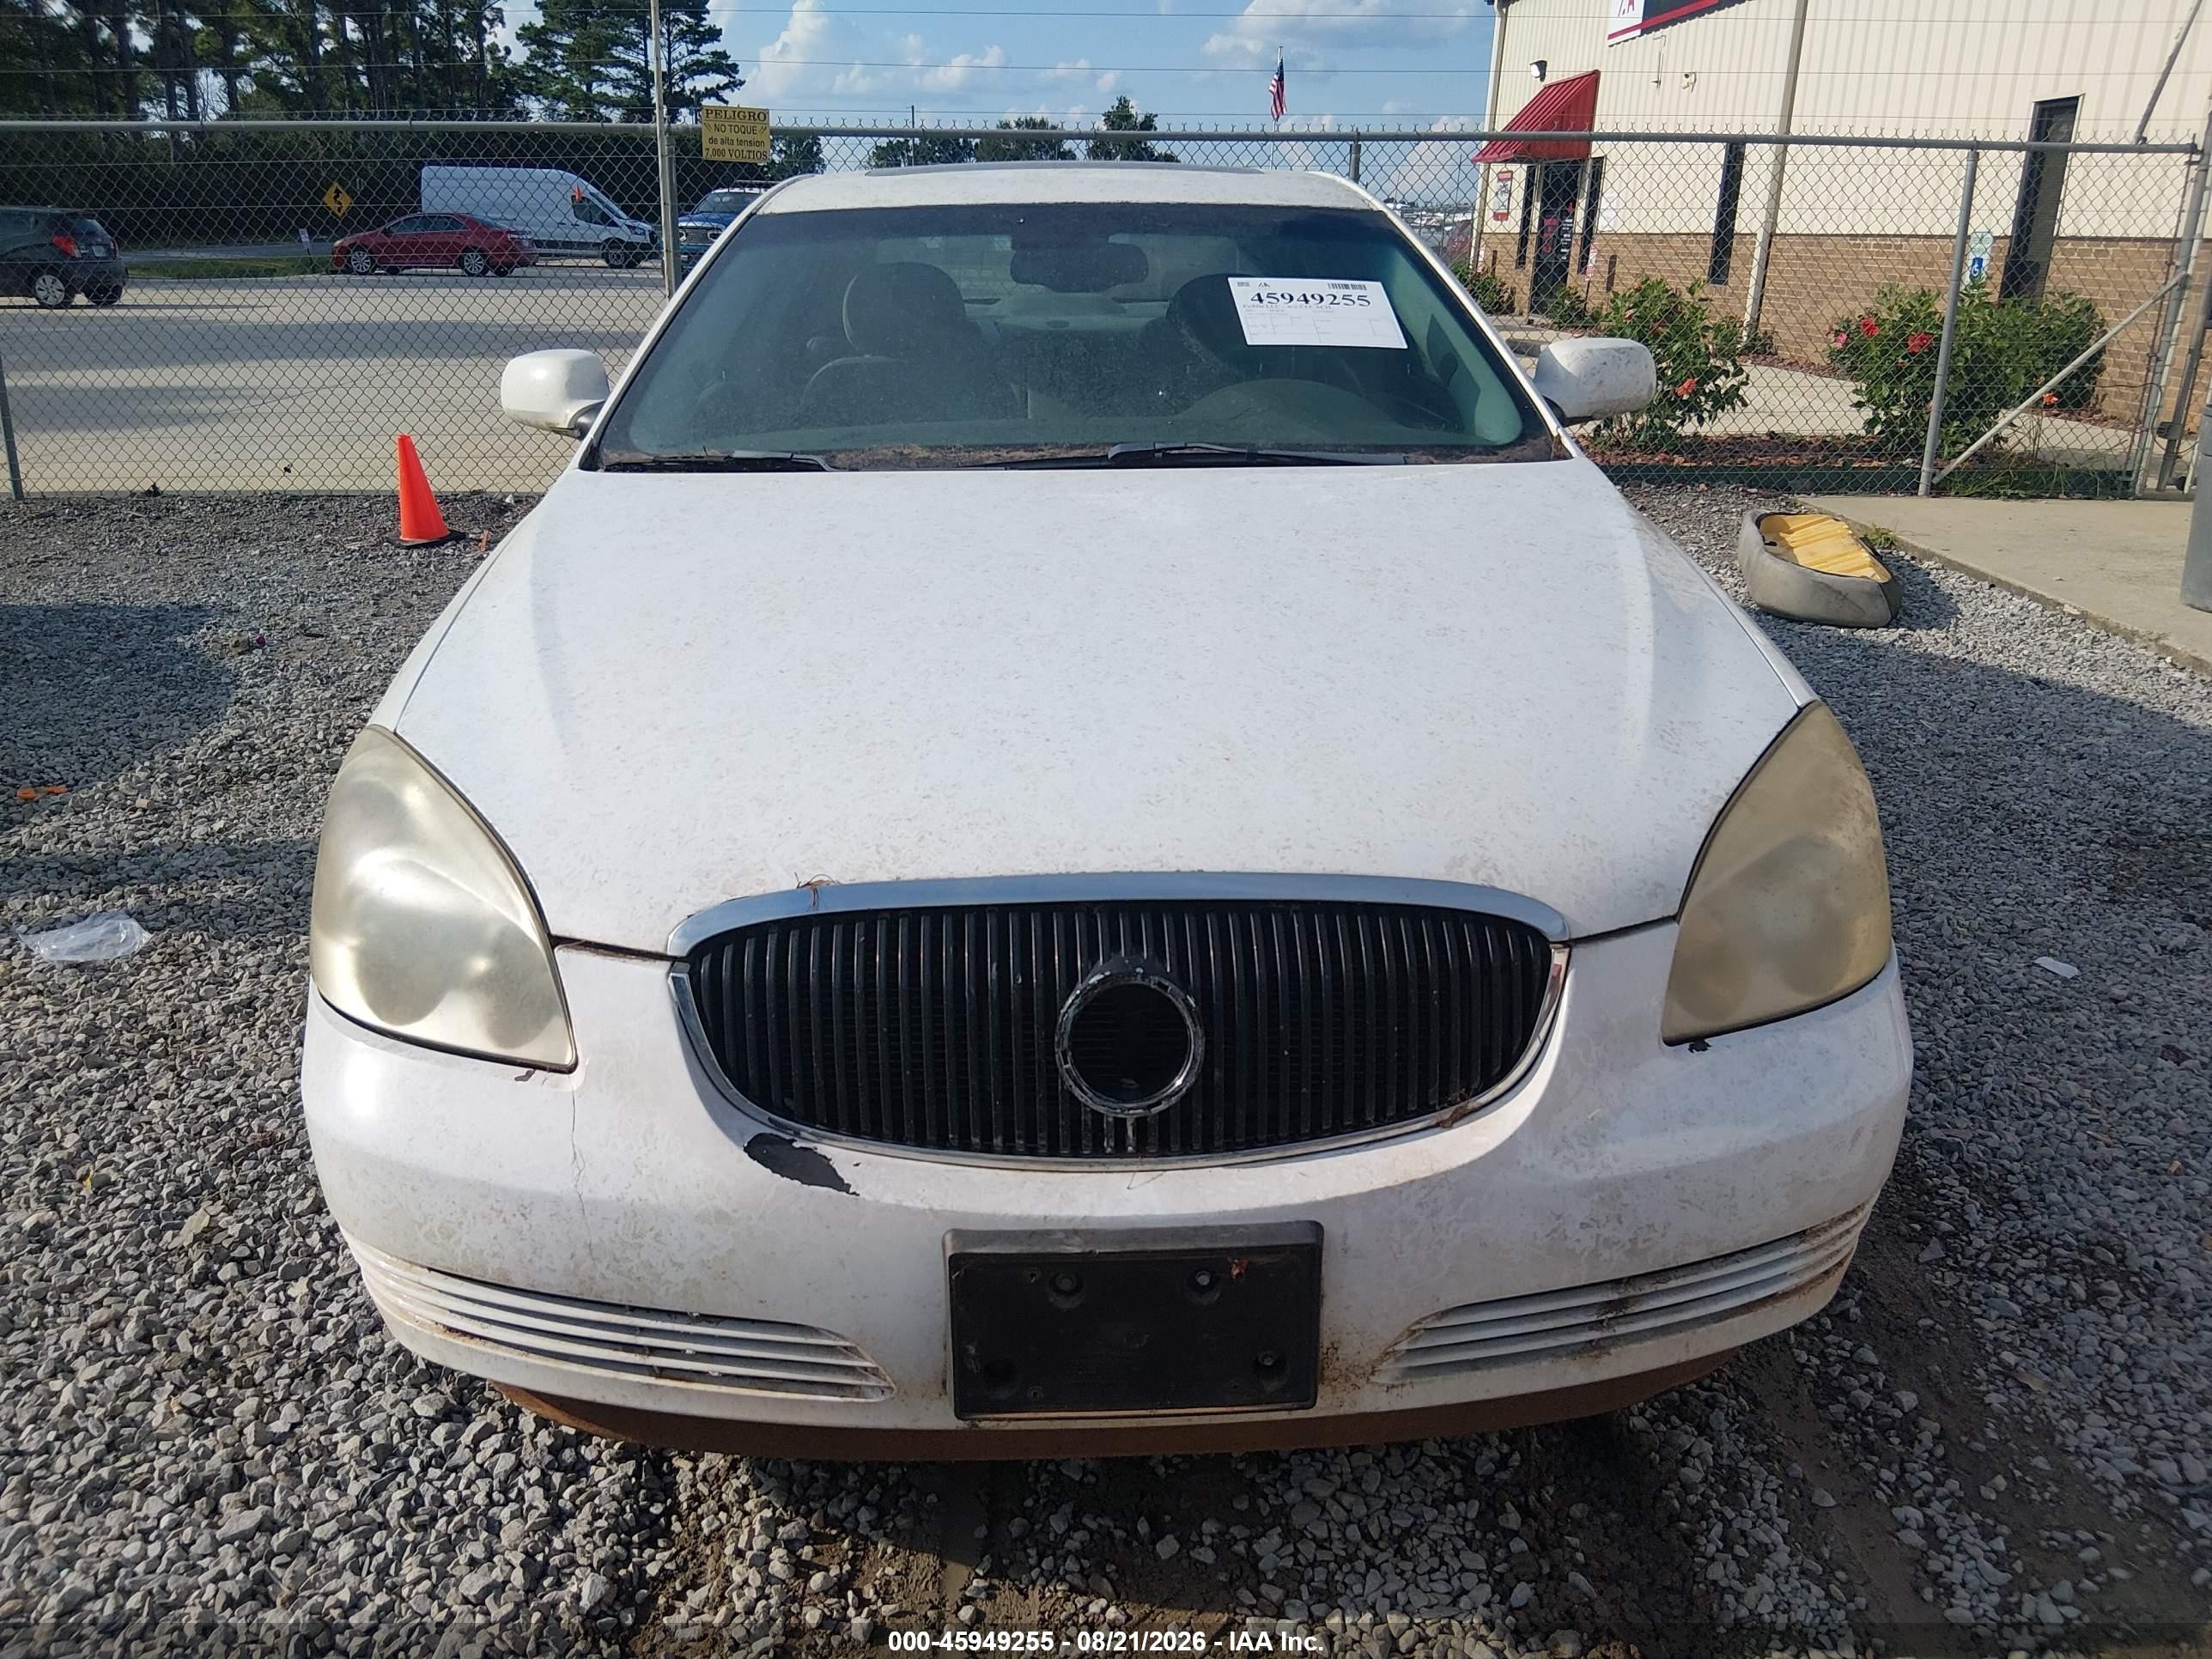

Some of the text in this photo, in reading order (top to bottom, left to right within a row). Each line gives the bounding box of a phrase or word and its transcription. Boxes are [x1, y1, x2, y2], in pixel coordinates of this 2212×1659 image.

[705, 109, 767, 122] PELIGRO
[714, 123, 757, 135] NO TOQUE
[708, 136, 765, 148] de alta tension
[728, 149, 768, 161] VOLTIOS
[1250, 292, 1371, 307] 45949255
